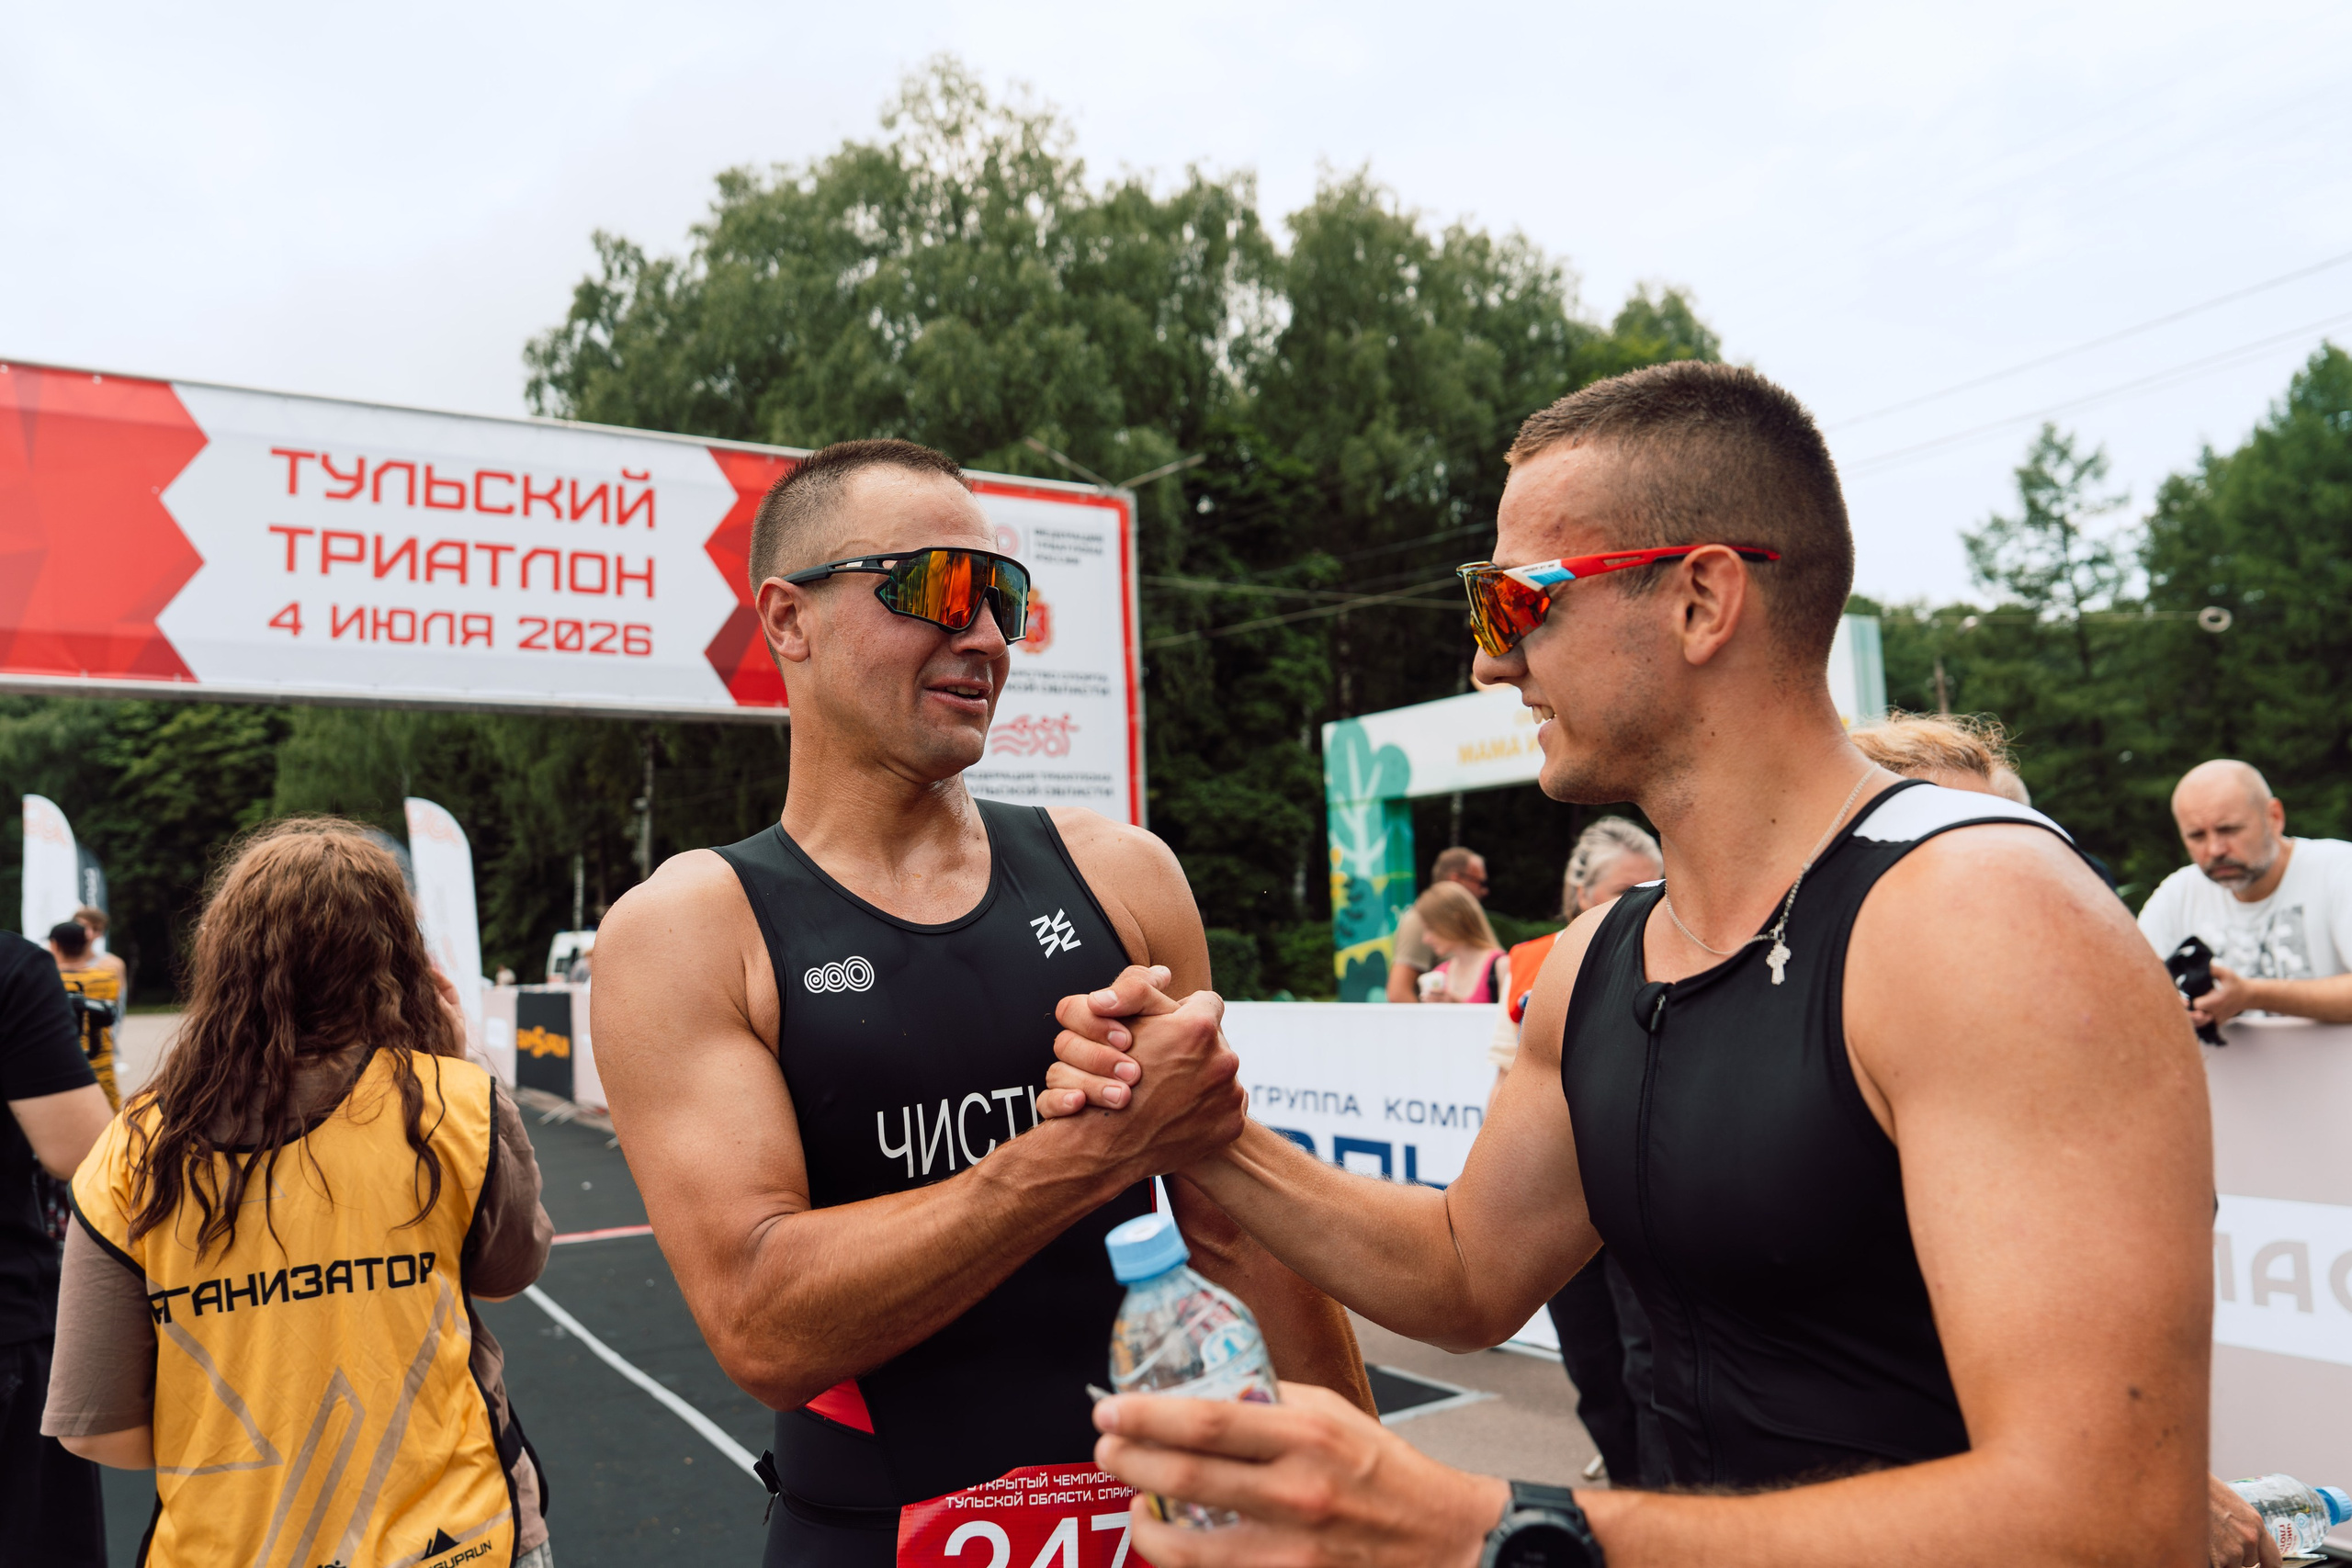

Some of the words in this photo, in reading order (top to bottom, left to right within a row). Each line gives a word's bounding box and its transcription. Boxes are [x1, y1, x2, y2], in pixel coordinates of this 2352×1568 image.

[270, 447, 656, 529] ТУЛЬСКИЙ
[268, 525, 656, 600] ТРИАТЛОН
[268, 602, 304, 637] 4
[331, 604, 494, 649] ИЮЛЯ
[517, 616, 654, 657] 2026
[1457, 735, 1521, 766] МАМА
[1251, 1085, 1361, 1116] ГРУППА
[945, 1491, 1023, 1508] ТУЛЬСКОЙ
[1029, 1490, 1094, 1506] ОБЛАСТИ,
[967, 1472, 1048, 1492] КРЫТЫЙ
[944, 1510, 1132, 1568] 247
